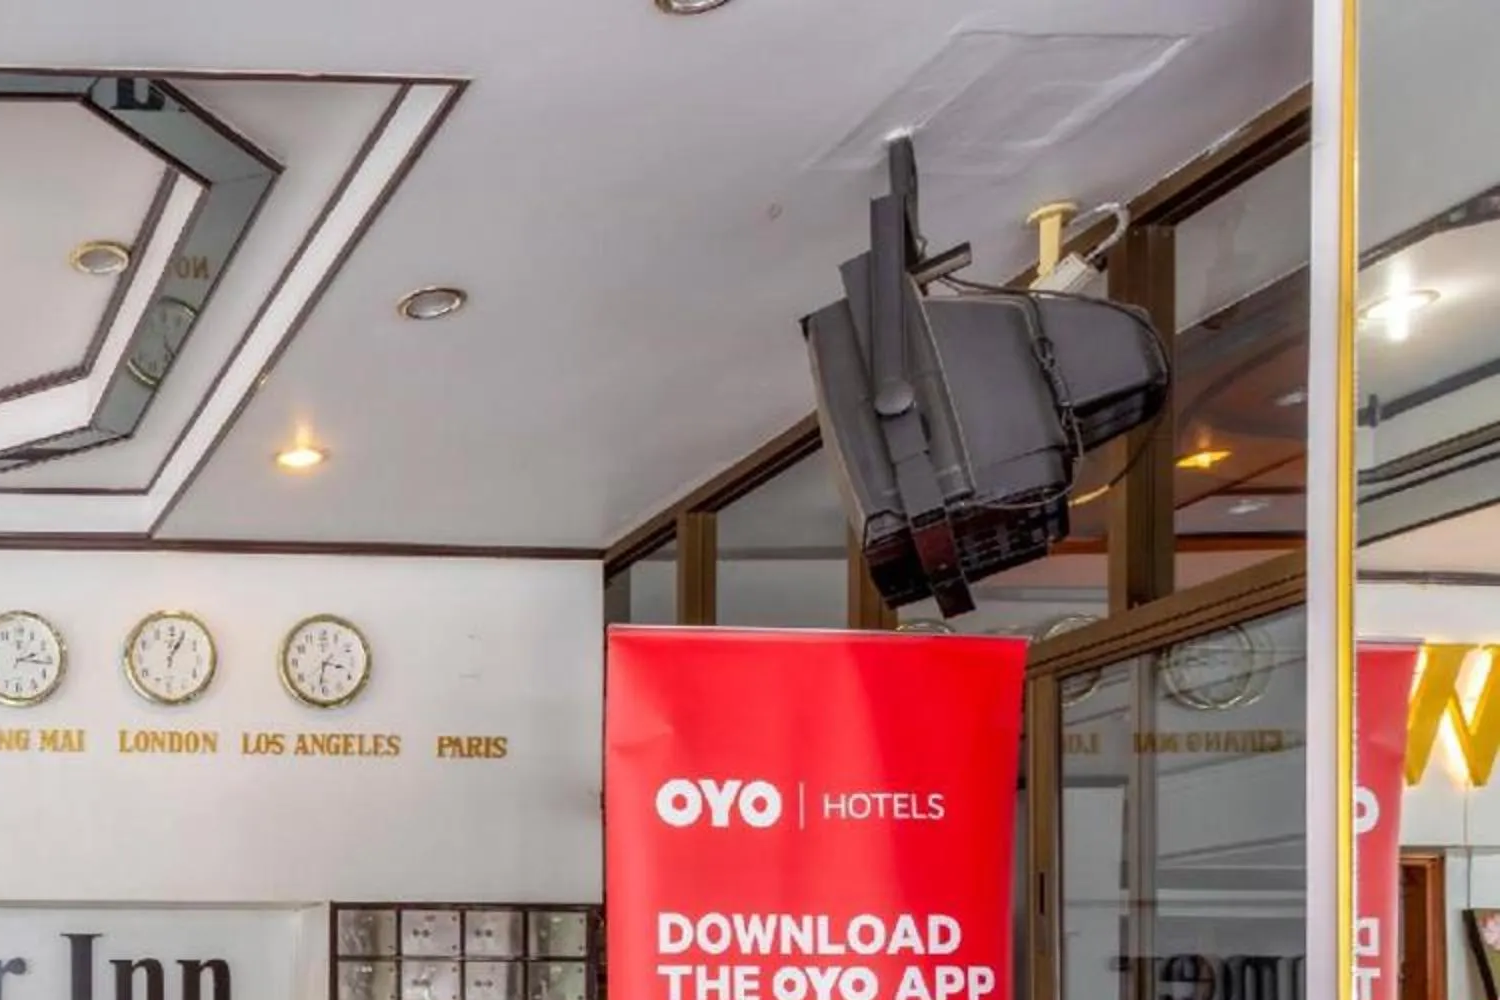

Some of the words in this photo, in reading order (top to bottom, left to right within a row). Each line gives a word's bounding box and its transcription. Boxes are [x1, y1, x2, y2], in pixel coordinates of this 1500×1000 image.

[38, 728, 85, 752] MAI
[119, 730, 218, 753] LONDON
[242, 732, 285, 755] LOS
[294, 733, 400, 756] ANGELES
[437, 735, 507, 758] PARIS
[655, 778, 782, 828] OYO
[823, 793, 946, 820] HOTELS
[658, 912, 962, 956] DOWNLOAD
